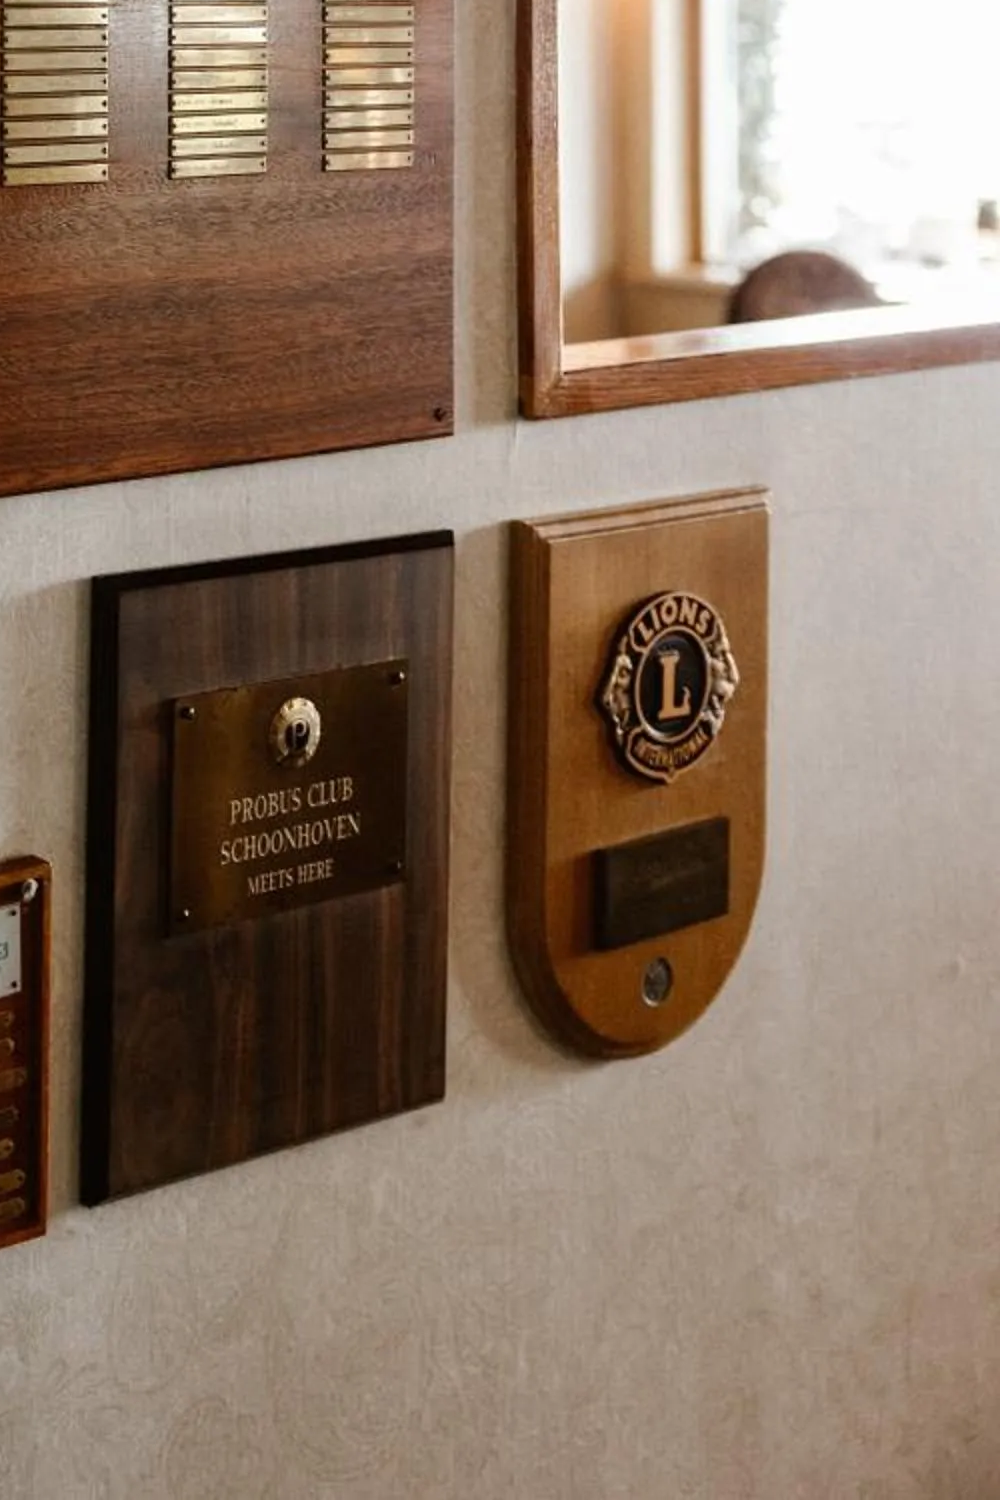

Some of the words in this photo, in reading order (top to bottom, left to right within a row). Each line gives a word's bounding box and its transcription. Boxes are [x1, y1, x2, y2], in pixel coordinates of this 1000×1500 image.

[638, 597, 712, 641] LIONS
[658, 651, 690, 720] L
[229, 787, 301, 826] PROBUS
[307, 776, 353, 808] CLUB
[221, 812, 360, 866] SCHOONHOVEN
[247, 867, 294, 896] MEETS
[297, 858, 334, 884] HERE
